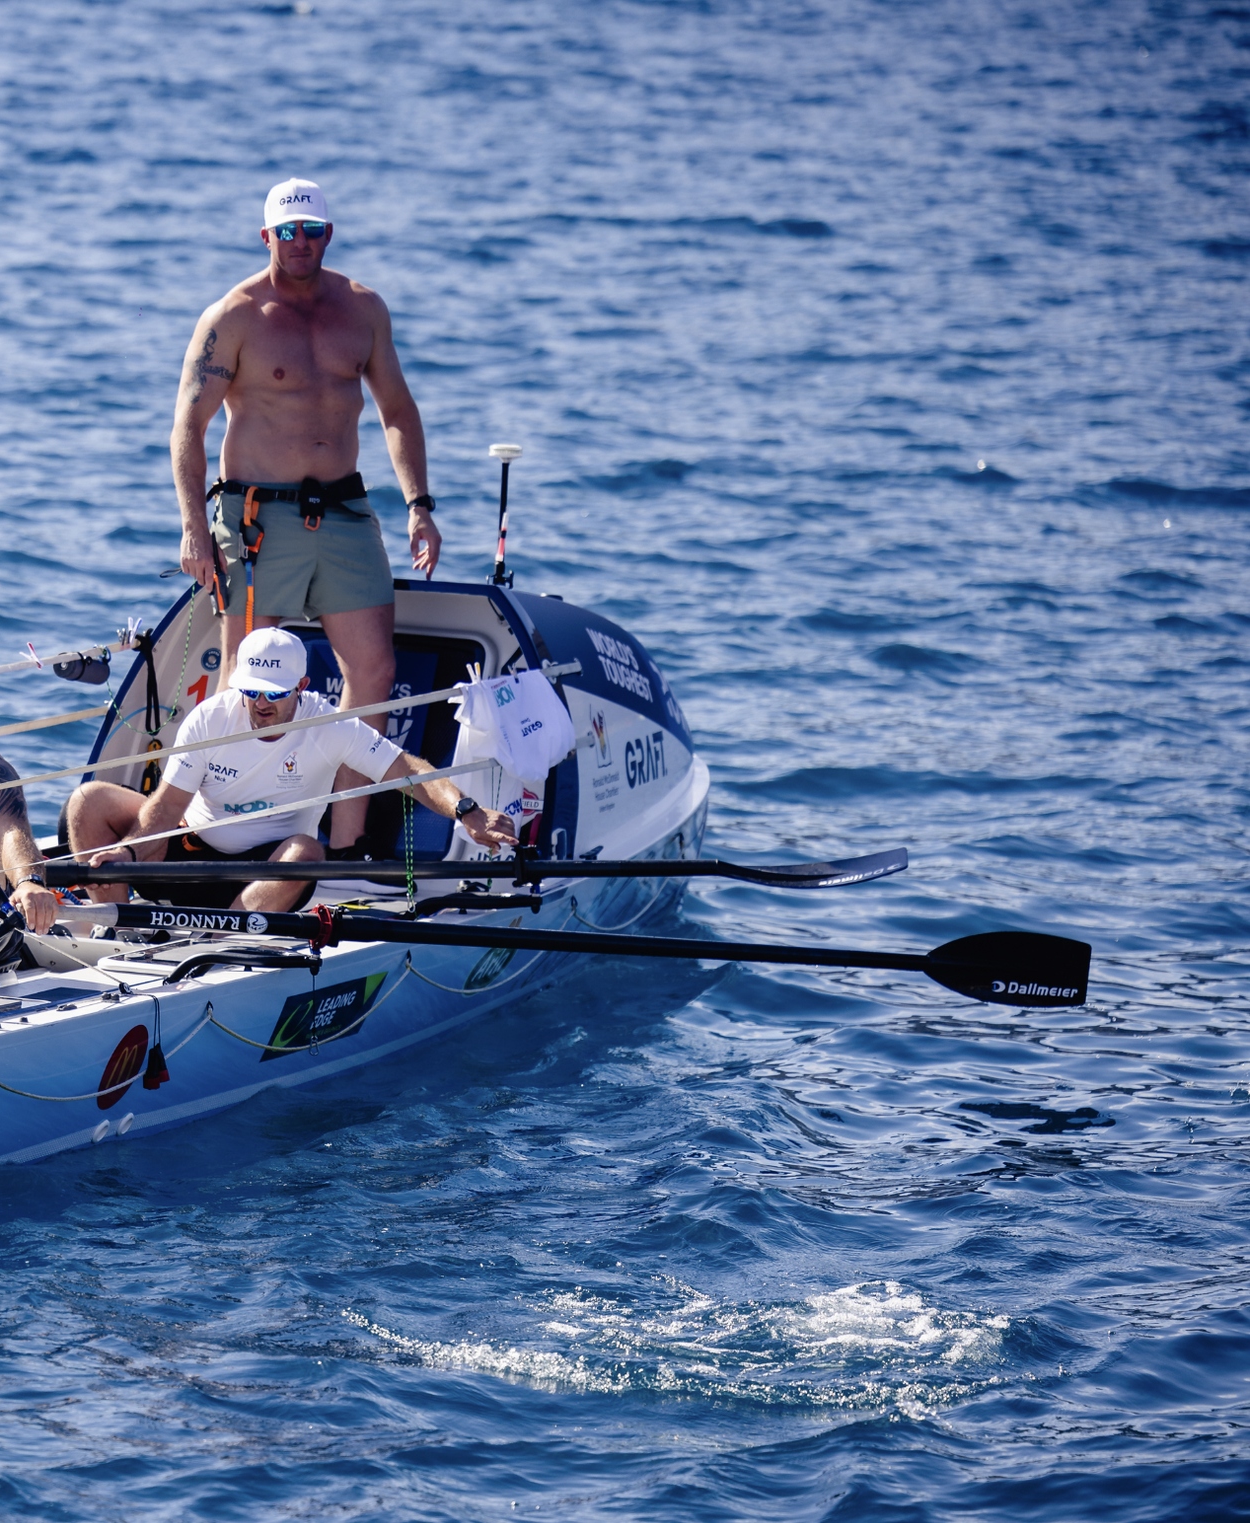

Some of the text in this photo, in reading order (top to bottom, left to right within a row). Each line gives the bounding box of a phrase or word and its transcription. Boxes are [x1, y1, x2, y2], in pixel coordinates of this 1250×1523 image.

[585, 627, 639, 671] WORLD'S
[597, 654, 653, 703] TOUGHEST
[214, 774, 227, 783] Nick
[150, 911, 240, 930] RANNOCH
[317, 990, 357, 1014] LEADING
[310, 1010, 337, 1030] EDGE
